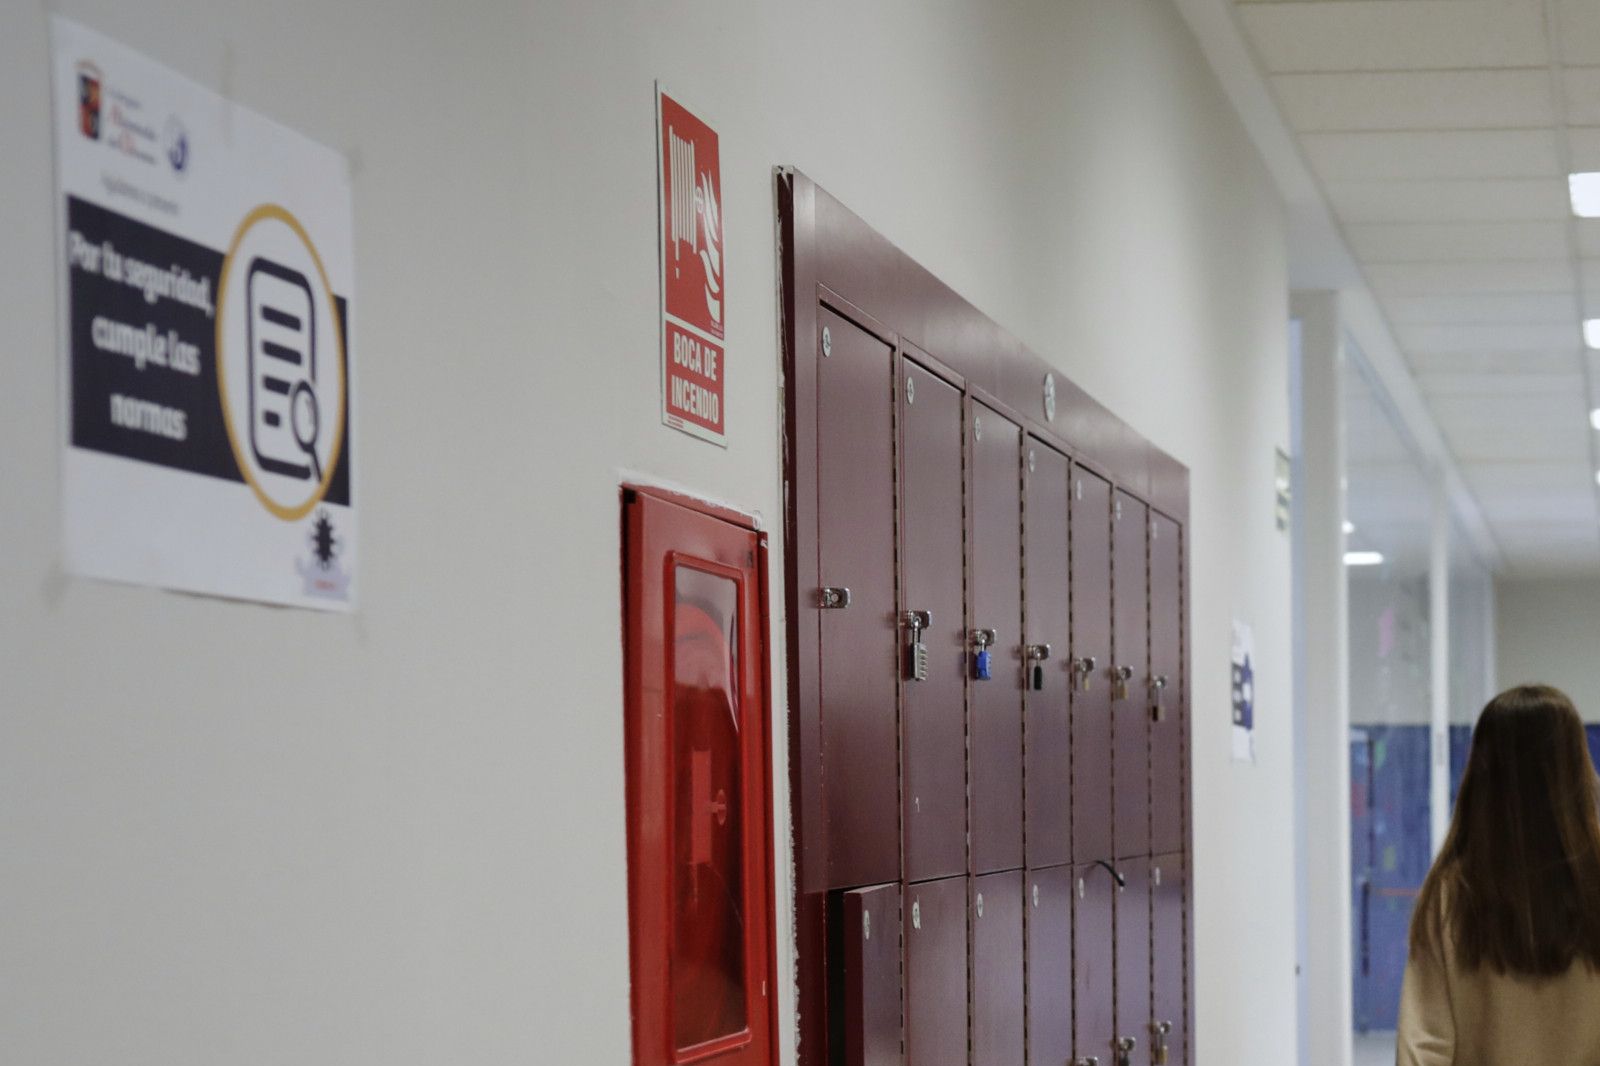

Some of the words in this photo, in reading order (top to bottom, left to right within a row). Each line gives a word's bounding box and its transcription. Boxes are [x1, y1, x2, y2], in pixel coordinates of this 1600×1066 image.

[69, 229, 101, 273] Por
[102, 239, 124, 283] la
[123, 262, 216, 319] seguridad,
[91, 314, 167, 371] cumple
[168, 328, 201, 376] las
[673, 330, 702, 375] BOCA
[703, 346, 717, 382] DE
[110, 393, 188, 441] normas
[671, 374, 719, 425] INCENDIO
